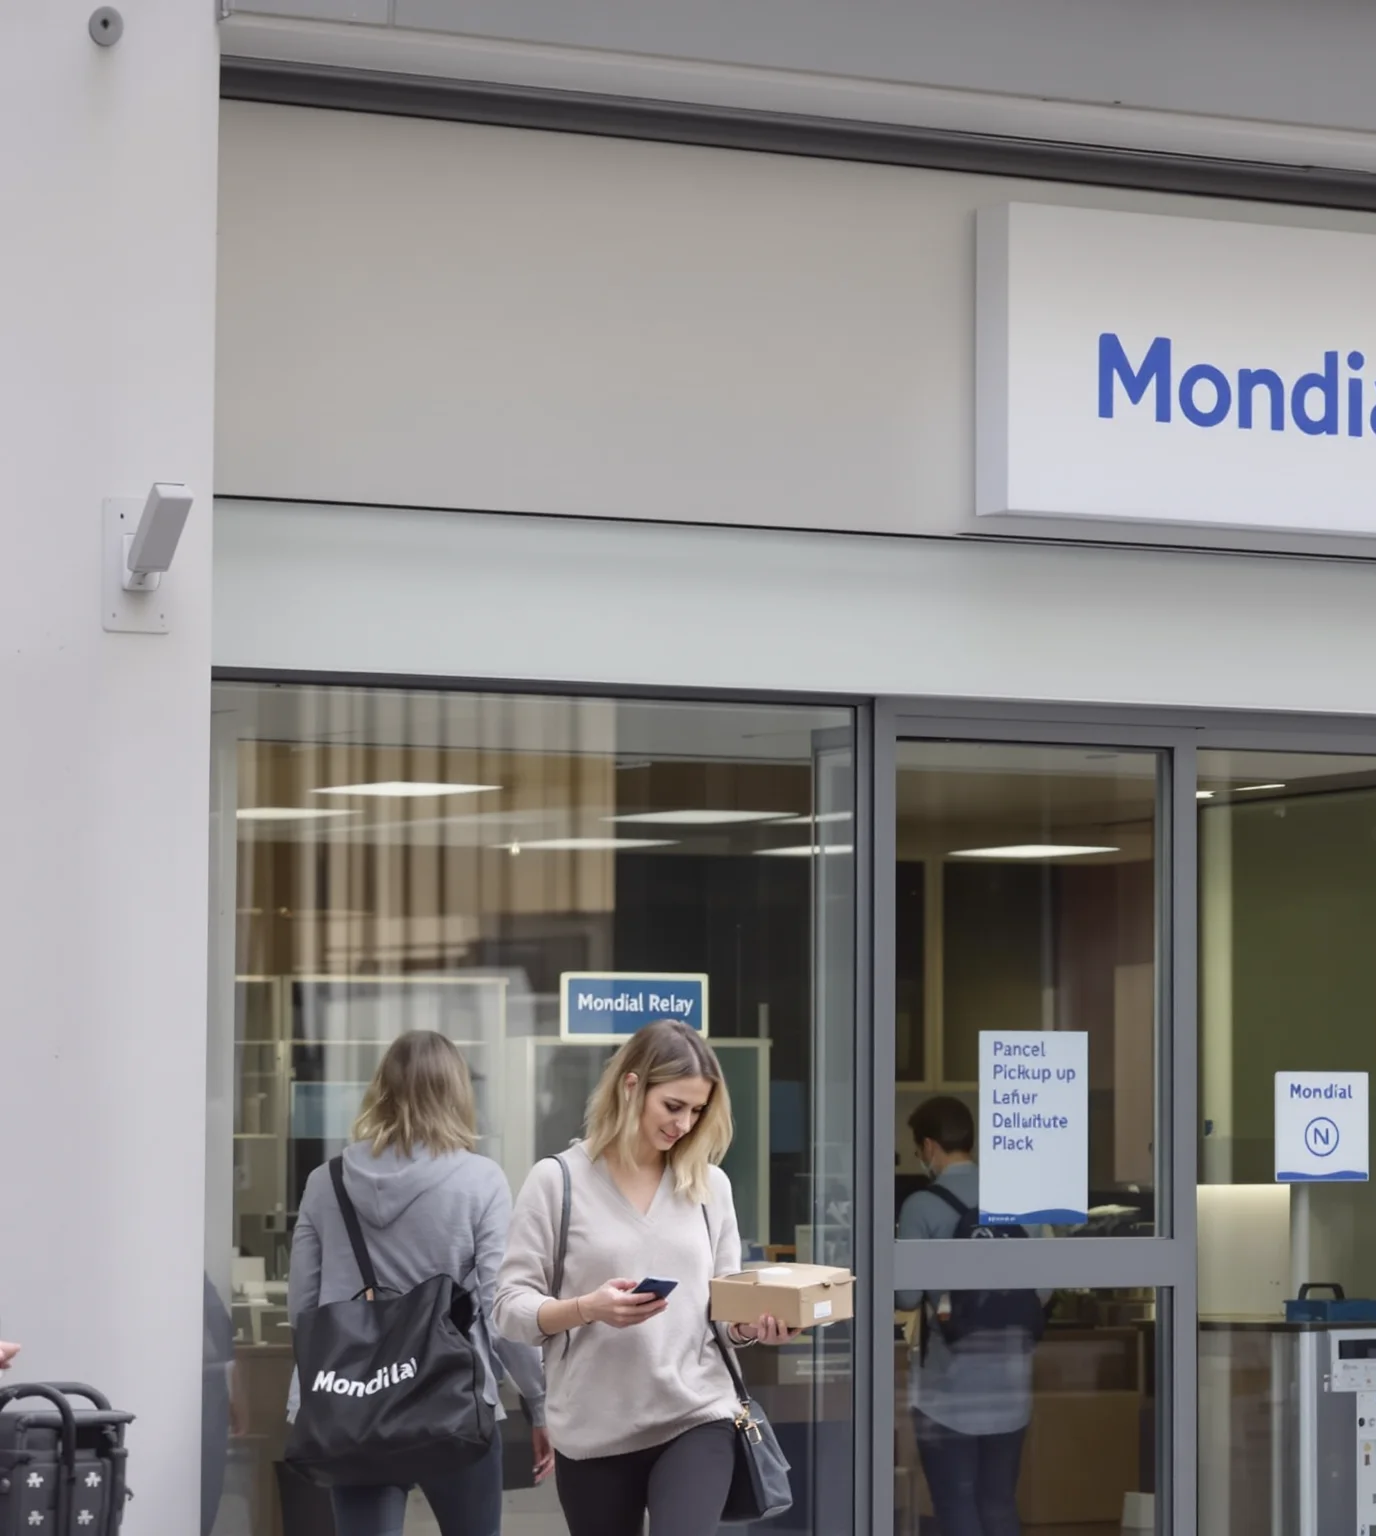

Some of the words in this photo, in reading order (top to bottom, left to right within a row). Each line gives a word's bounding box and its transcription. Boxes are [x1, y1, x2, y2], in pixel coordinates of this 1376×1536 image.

[577, 992, 644, 1013] Mondial
[648, 993, 694, 1017] Relay
[1056, 1068, 1076, 1084] up
[1290, 1083, 1353, 1100] Mondial
[992, 1135, 1034, 1151] Plack
